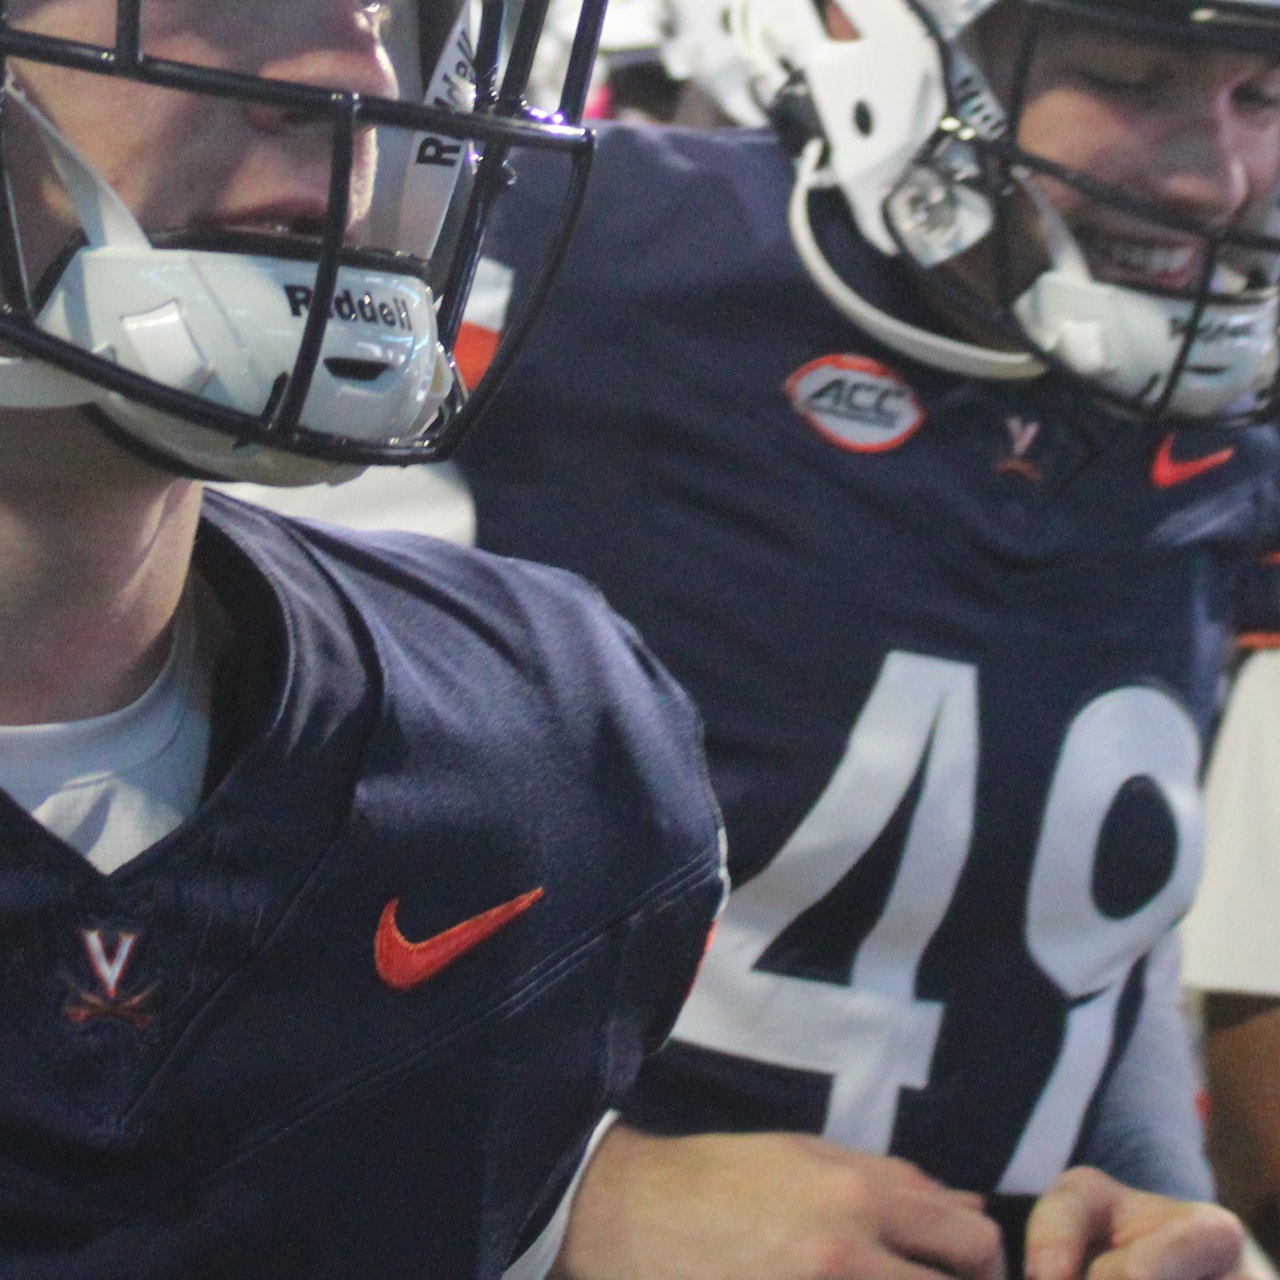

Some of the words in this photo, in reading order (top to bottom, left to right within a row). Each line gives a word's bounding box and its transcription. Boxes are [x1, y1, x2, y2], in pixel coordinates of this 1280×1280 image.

[284, 284, 412, 332] Rddell
[808, 378, 906, 424] ACC
[670, 650, 1205, 1195] 49
